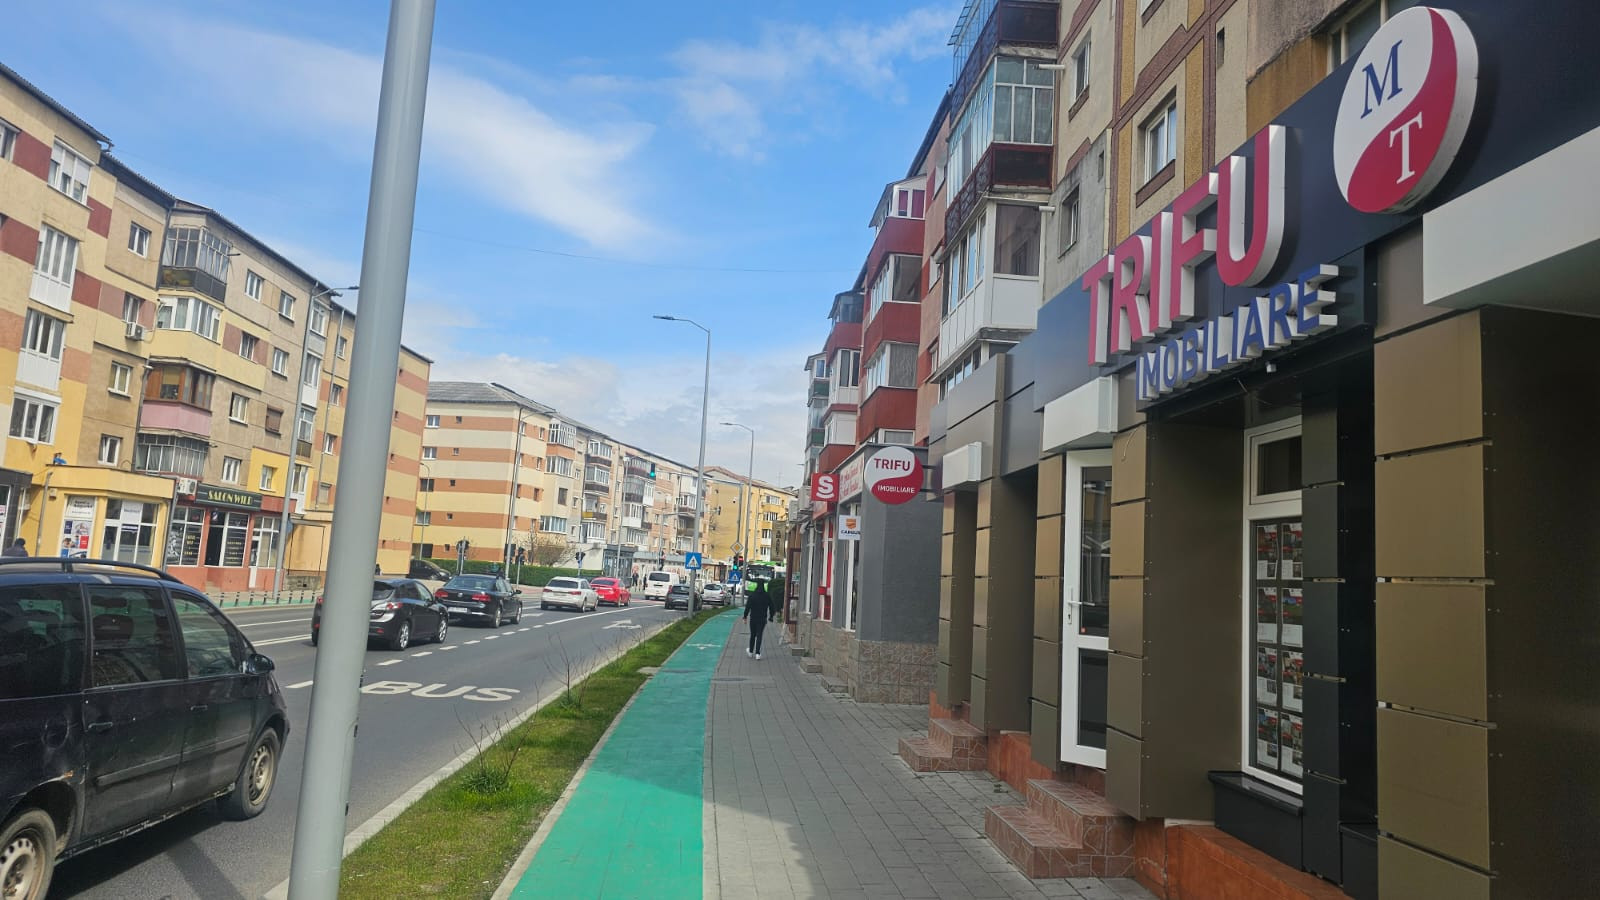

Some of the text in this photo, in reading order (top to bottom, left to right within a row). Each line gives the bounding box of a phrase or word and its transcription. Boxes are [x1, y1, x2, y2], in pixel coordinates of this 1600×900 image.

[1360, 39, 1403, 119] M
[1389, 111, 1422, 185] T
[1082, 124, 1286, 367] TRIFU
[1136, 264, 1338, 401] IMOBILIARE
[873, 458, 911, 472] TRIFU
[817, 475, 834, 494] S
[877, 486, 915, 494] IMOBILIARE
[208, 490, 233, 503] SALON
[360, 680, 520, 702] BUS
